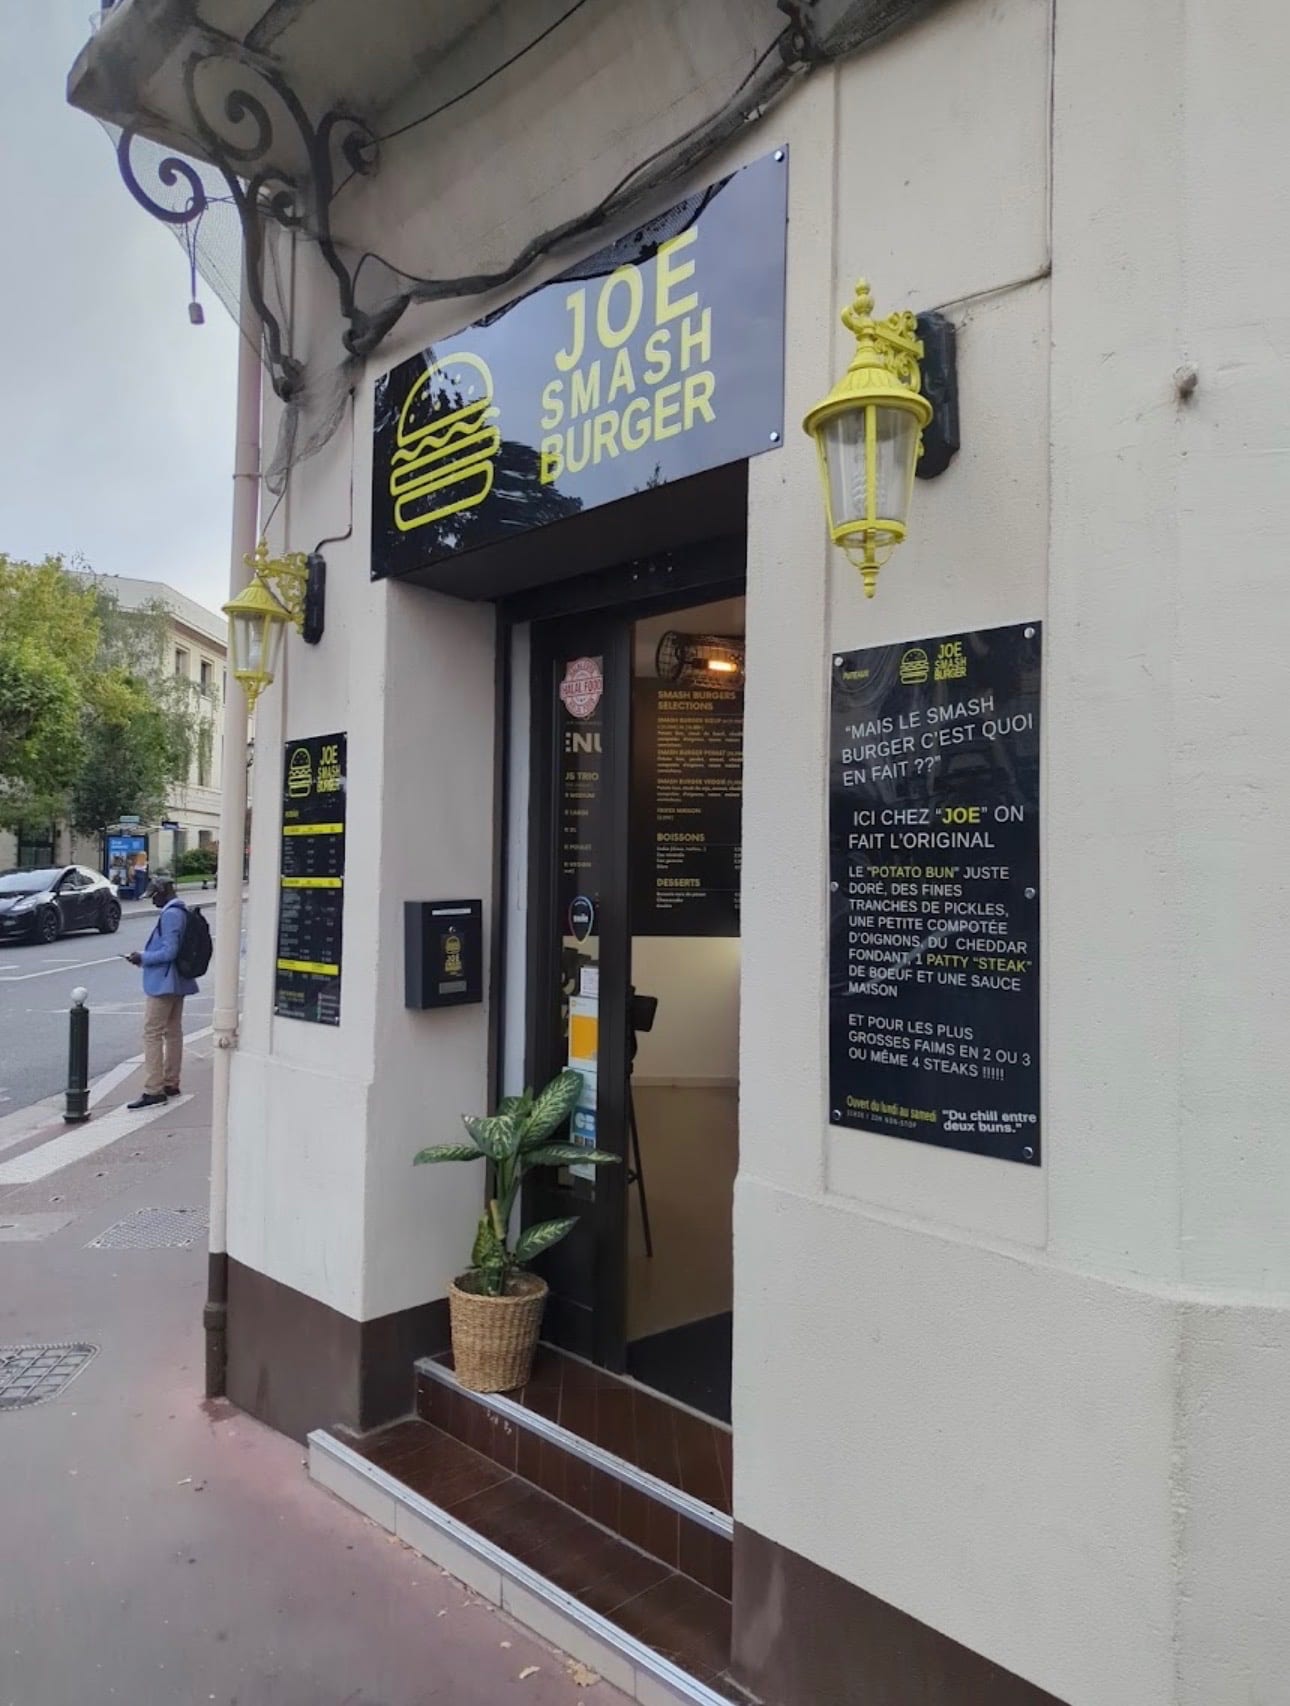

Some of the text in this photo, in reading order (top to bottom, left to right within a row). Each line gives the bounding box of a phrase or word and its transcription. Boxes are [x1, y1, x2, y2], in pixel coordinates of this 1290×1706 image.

[555, 225, 698, 372] JOE
[540, 307, 712, 430] SMASH
[539, 370, 716, 486] BURGER
[938, 641, 962, 659] JOE
[935, 656, 967, 669] SMASH
[934, 666, 967, 680] BURGER
[657, 690, 736, 700] SMASH BURGERS
[657, 701, 713, 711] SELECTIONS
[900, 711, 921, 729] LE
[927, 695, 994, 724] SMASH
[842, 713, 1033, 764] BURGER C'EST QUOI
[320, 744, 338, 765] JOE
[576, 772, 600, 781] TRIO
[843, 769, 866, 786] EN
[872, 760, 909, 782] FAIT
[854, 810, 876, 826] ICI
[881, 808, 930, 825] CHEZ
[994, 805, 1024, 822] ON
[656, 833, 705, 842] BOISSONS
[849, 832, 995, 849] FAIT L'ORIGINAL
[656, 878, 701, 887] DESSERTS
[849, 866, 864, 878] LE
[963, 866, 1010, 880] JUSTE
[849, 881, 963, 897] DORÉ, DES FINES
[849, 899, 1009, 918] TRANCHES DE PICKLES,
[849, 916, 1008, 935] UNE PETITE COMPOTÉE
[928, 936, 948, 949] DU
[956, 938, 1027, 954] CHEDDAR
[849, 948, 911, 965] FONDANT,
[915, 953, 923, 965] 1
[926, 953, 969, 968] PATTY
[849, 964, 866, 977] DE
[917, 970, 934, 983] ET
[937, 973, 967, 986] UNE
[971, 975, 1021, 991] SAUCE
[849, 981, 898, 997] MAISON
[849, 1013, 974, 1040] ET POUR LES PLUS
[849, 1030, 1031, 1066] GROSSES FAIMS EN 2 OU 3
[849, 1047, 867, 1060] OU
[871, 1049, 909, 1067] MÊME
[912, 1056, 919, 1068] 4
[924, 1058, 979, 1077] STEAKS
[575, 1112, 595, 1131] CB
[970, 1109, 998, 1121] chill
[1002, 1112, 1037, 1123] entre
[943, 1120, 975, 1132] deux
